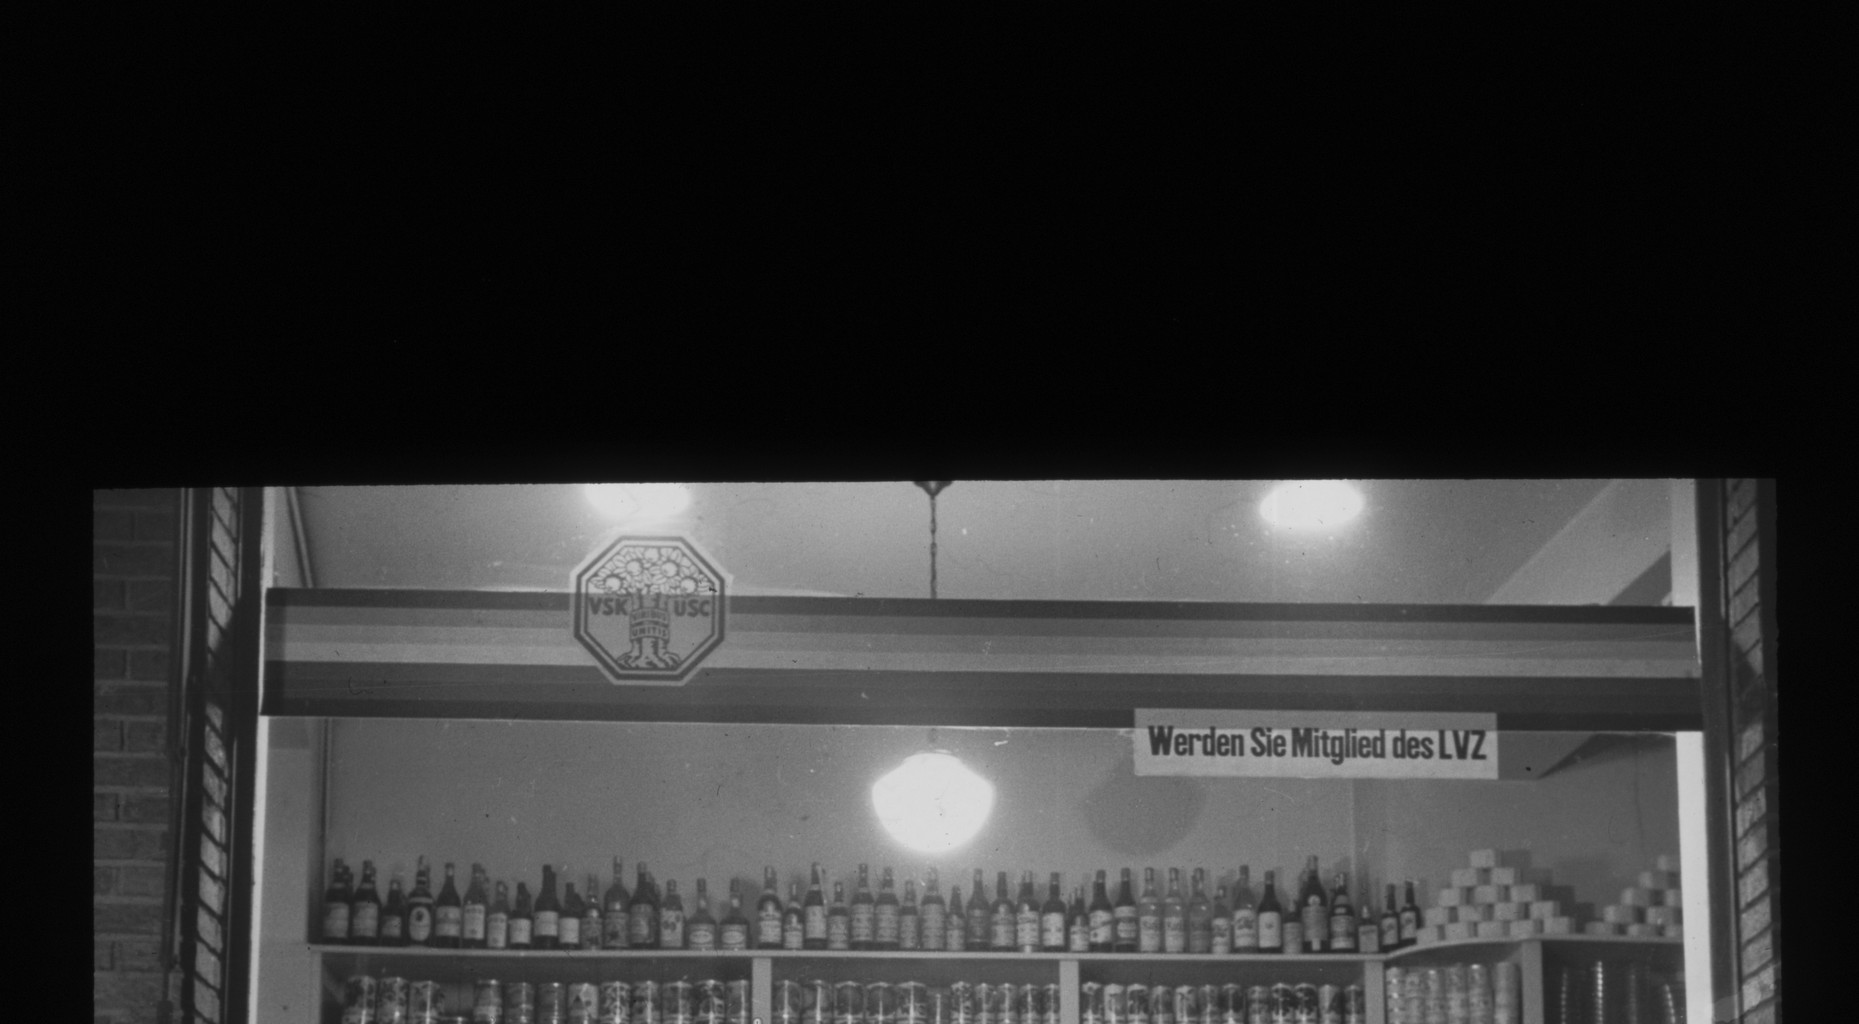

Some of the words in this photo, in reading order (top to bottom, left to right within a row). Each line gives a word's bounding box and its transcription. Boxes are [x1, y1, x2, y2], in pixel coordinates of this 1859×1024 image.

[587, 597, 629, 616] VSK
[673, 599, 710, 617] USC
[1148, 725, 1245, 757] Werden
[1251, 727, 1287, 757] Sie
[1291, 727, 1386, 766] Mitglied
[1392, 728, 1435, 760] des
[1439, 729, 1487, 760] LVZ
